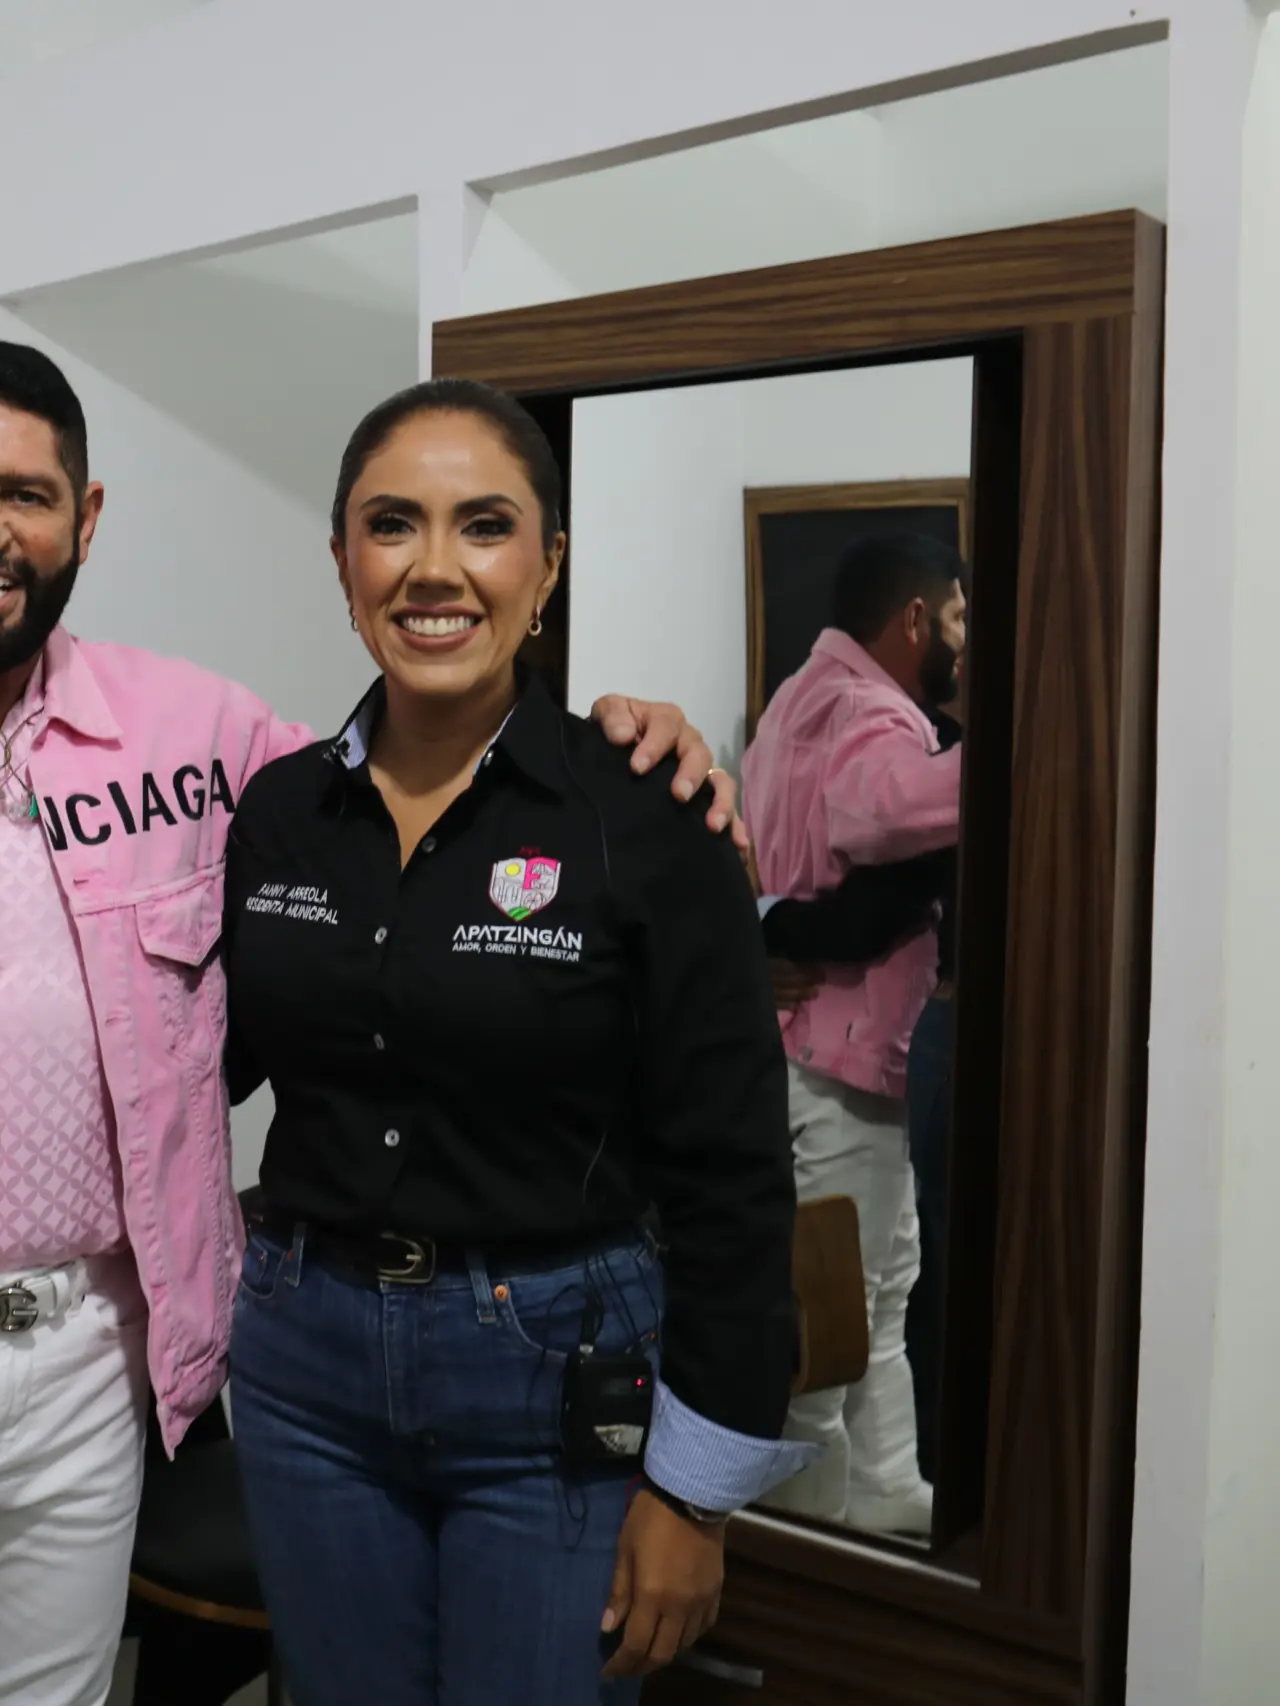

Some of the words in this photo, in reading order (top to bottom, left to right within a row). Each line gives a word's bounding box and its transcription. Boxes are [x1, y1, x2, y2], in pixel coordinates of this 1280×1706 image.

[257, 883, 288, 898] FANNY
[286, 886, 328, 905] ARREOLA
[285, 902, 338, 925] MUNICIPAL
[453, 924, 582, 950] APATZINGÁN
[452, 942, 481, 954] AMOR,
[485, 943, 517, 954] ORDEN
[520, 945, 528, 955] Y
[530, 946, 580, 962] BIENESTAR
